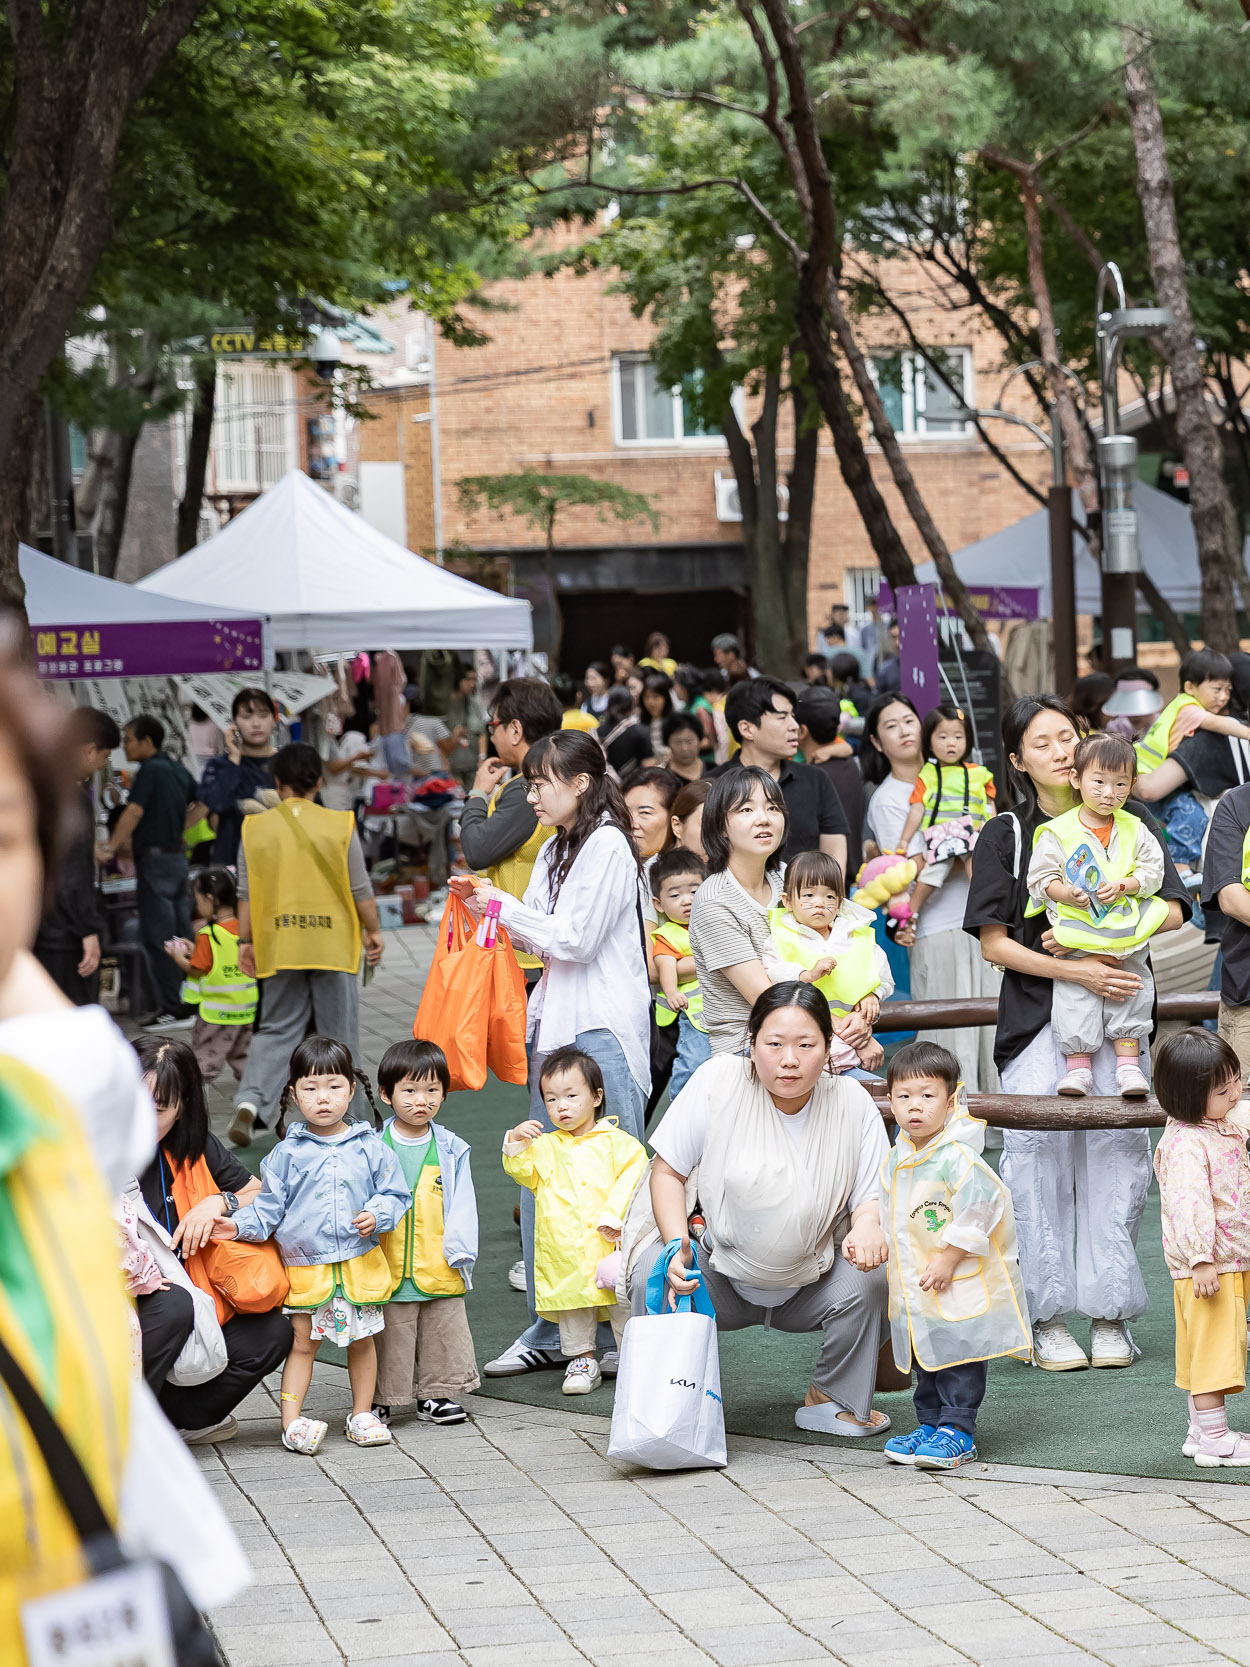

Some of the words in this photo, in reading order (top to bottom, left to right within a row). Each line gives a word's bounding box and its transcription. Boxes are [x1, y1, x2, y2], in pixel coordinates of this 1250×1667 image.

[211, 334, 255, 352] CCTV
[36, 631, 100, 655] 예교실
[670, 1378, 696, 1390] KIA
